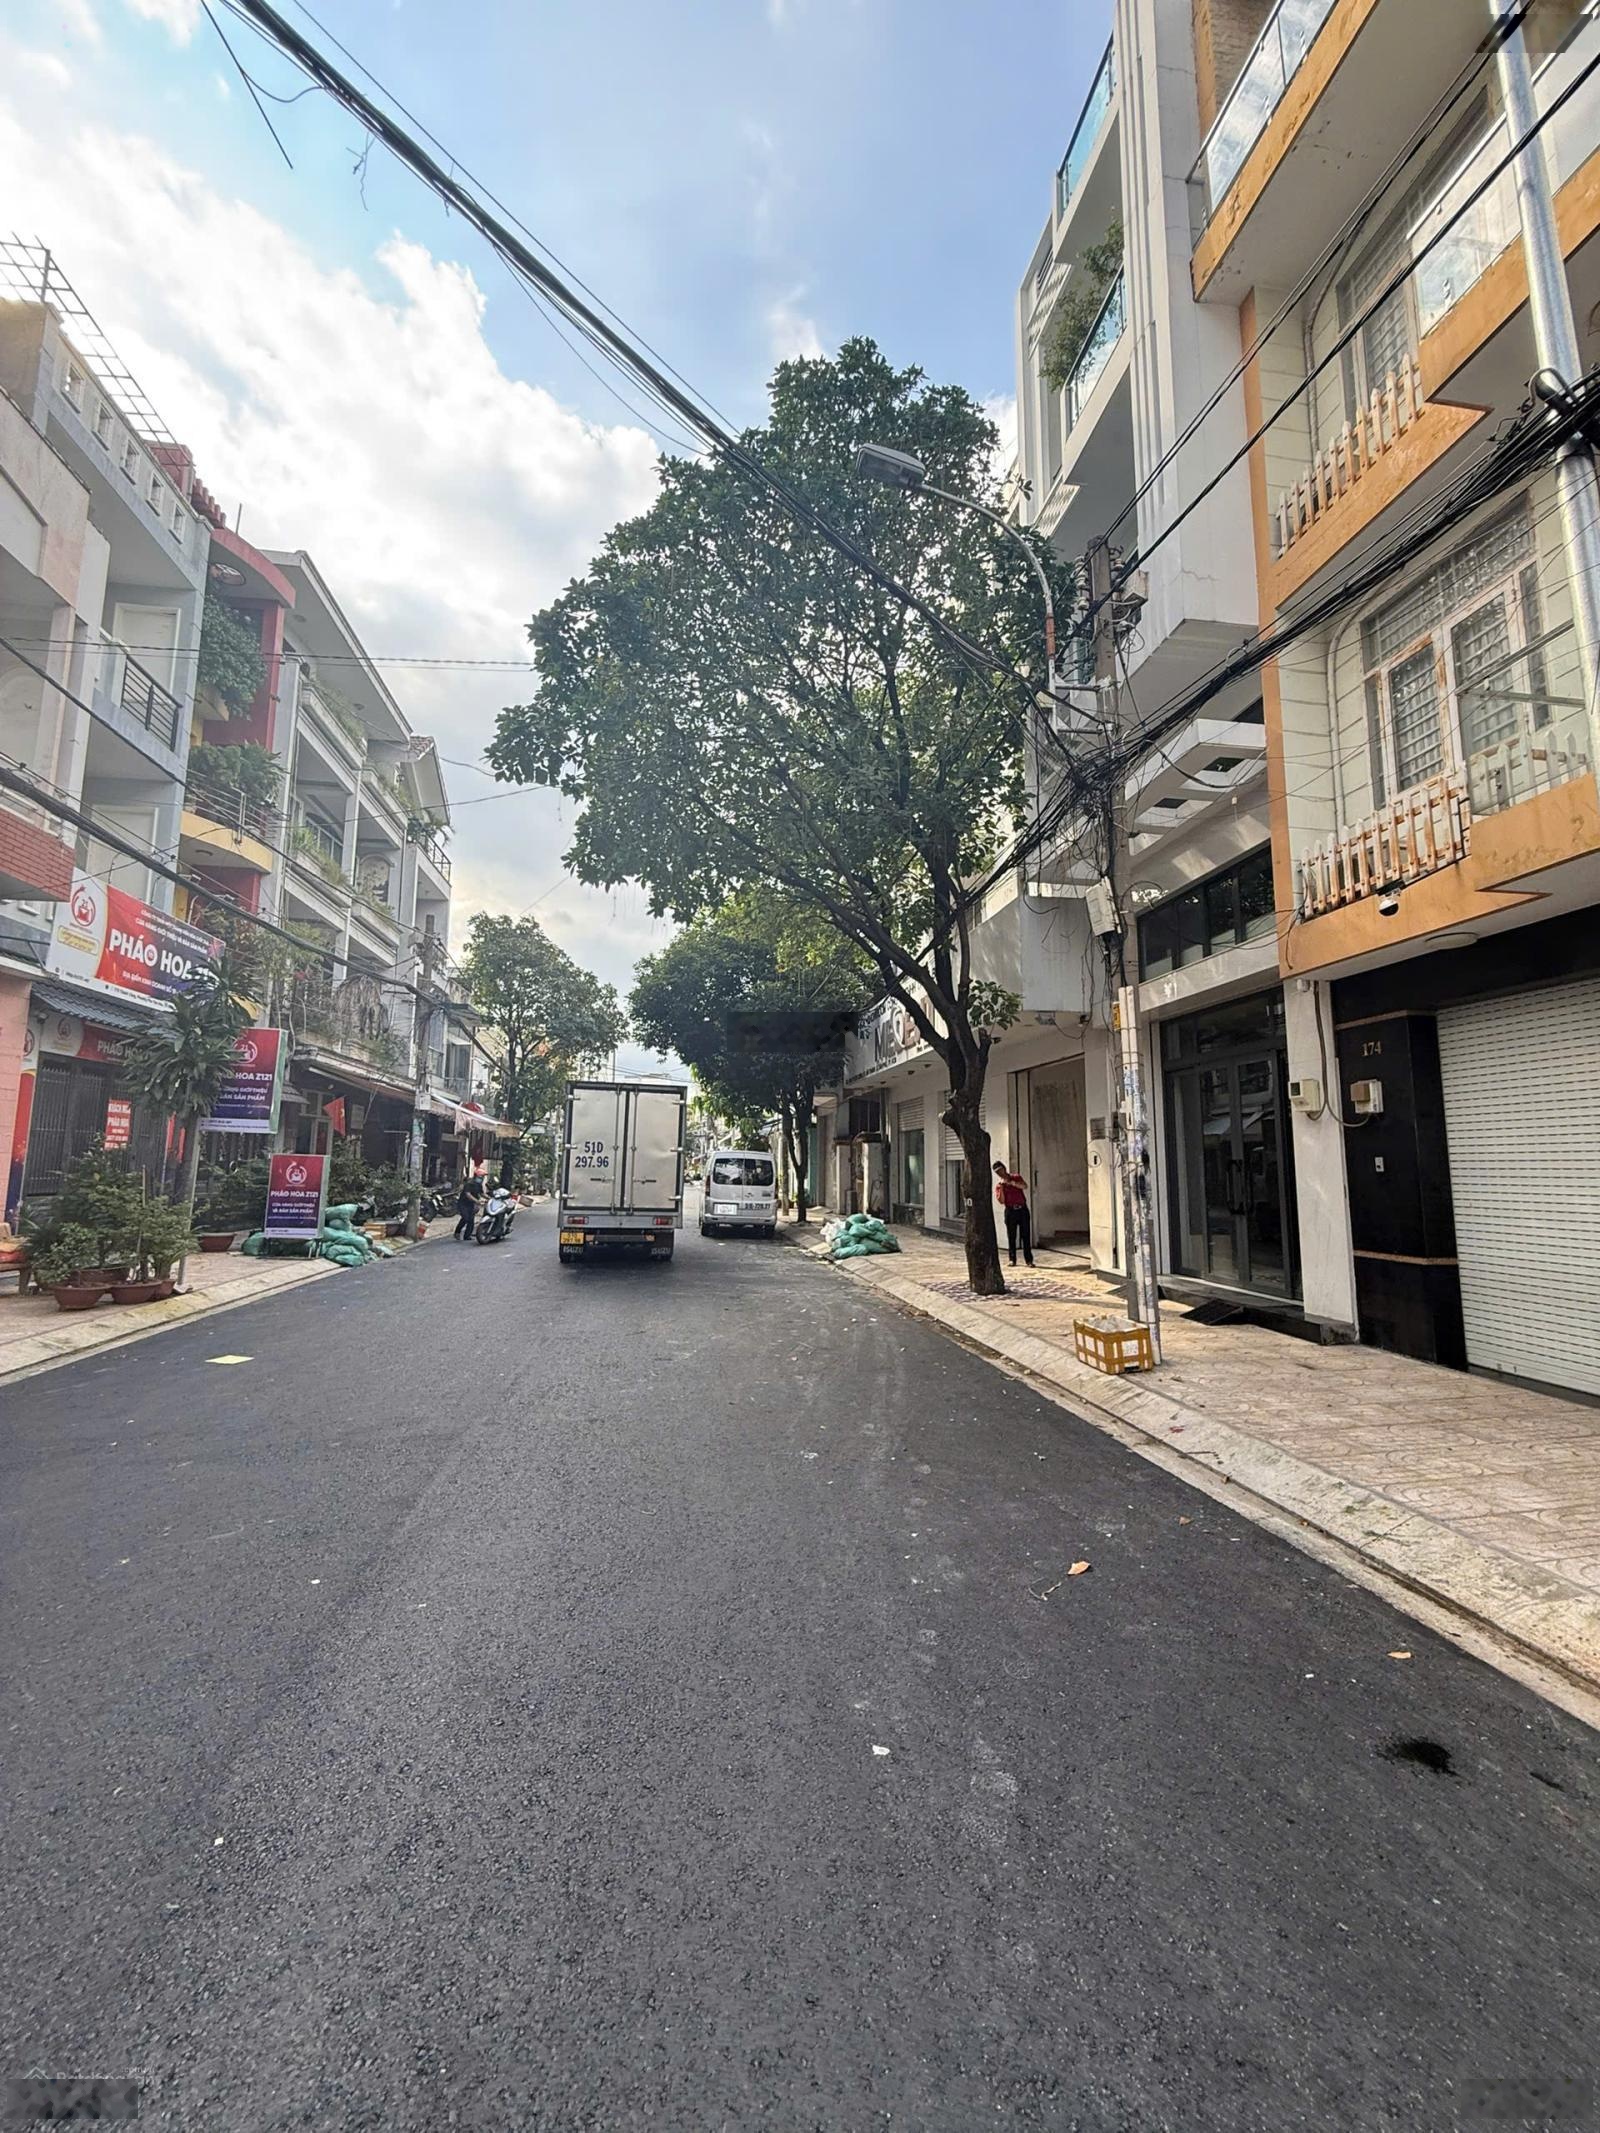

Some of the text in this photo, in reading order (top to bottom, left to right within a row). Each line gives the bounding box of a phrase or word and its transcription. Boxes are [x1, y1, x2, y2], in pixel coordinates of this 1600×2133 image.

[108, 929, 158, 967] PHÁO
[1362, 1040, 1382, 1056] 174
[235, 1072, 255, 1080] HOA
[584, 1141, 604, 1153] 51D
[575, 1156, 609, 1168] 297.96
